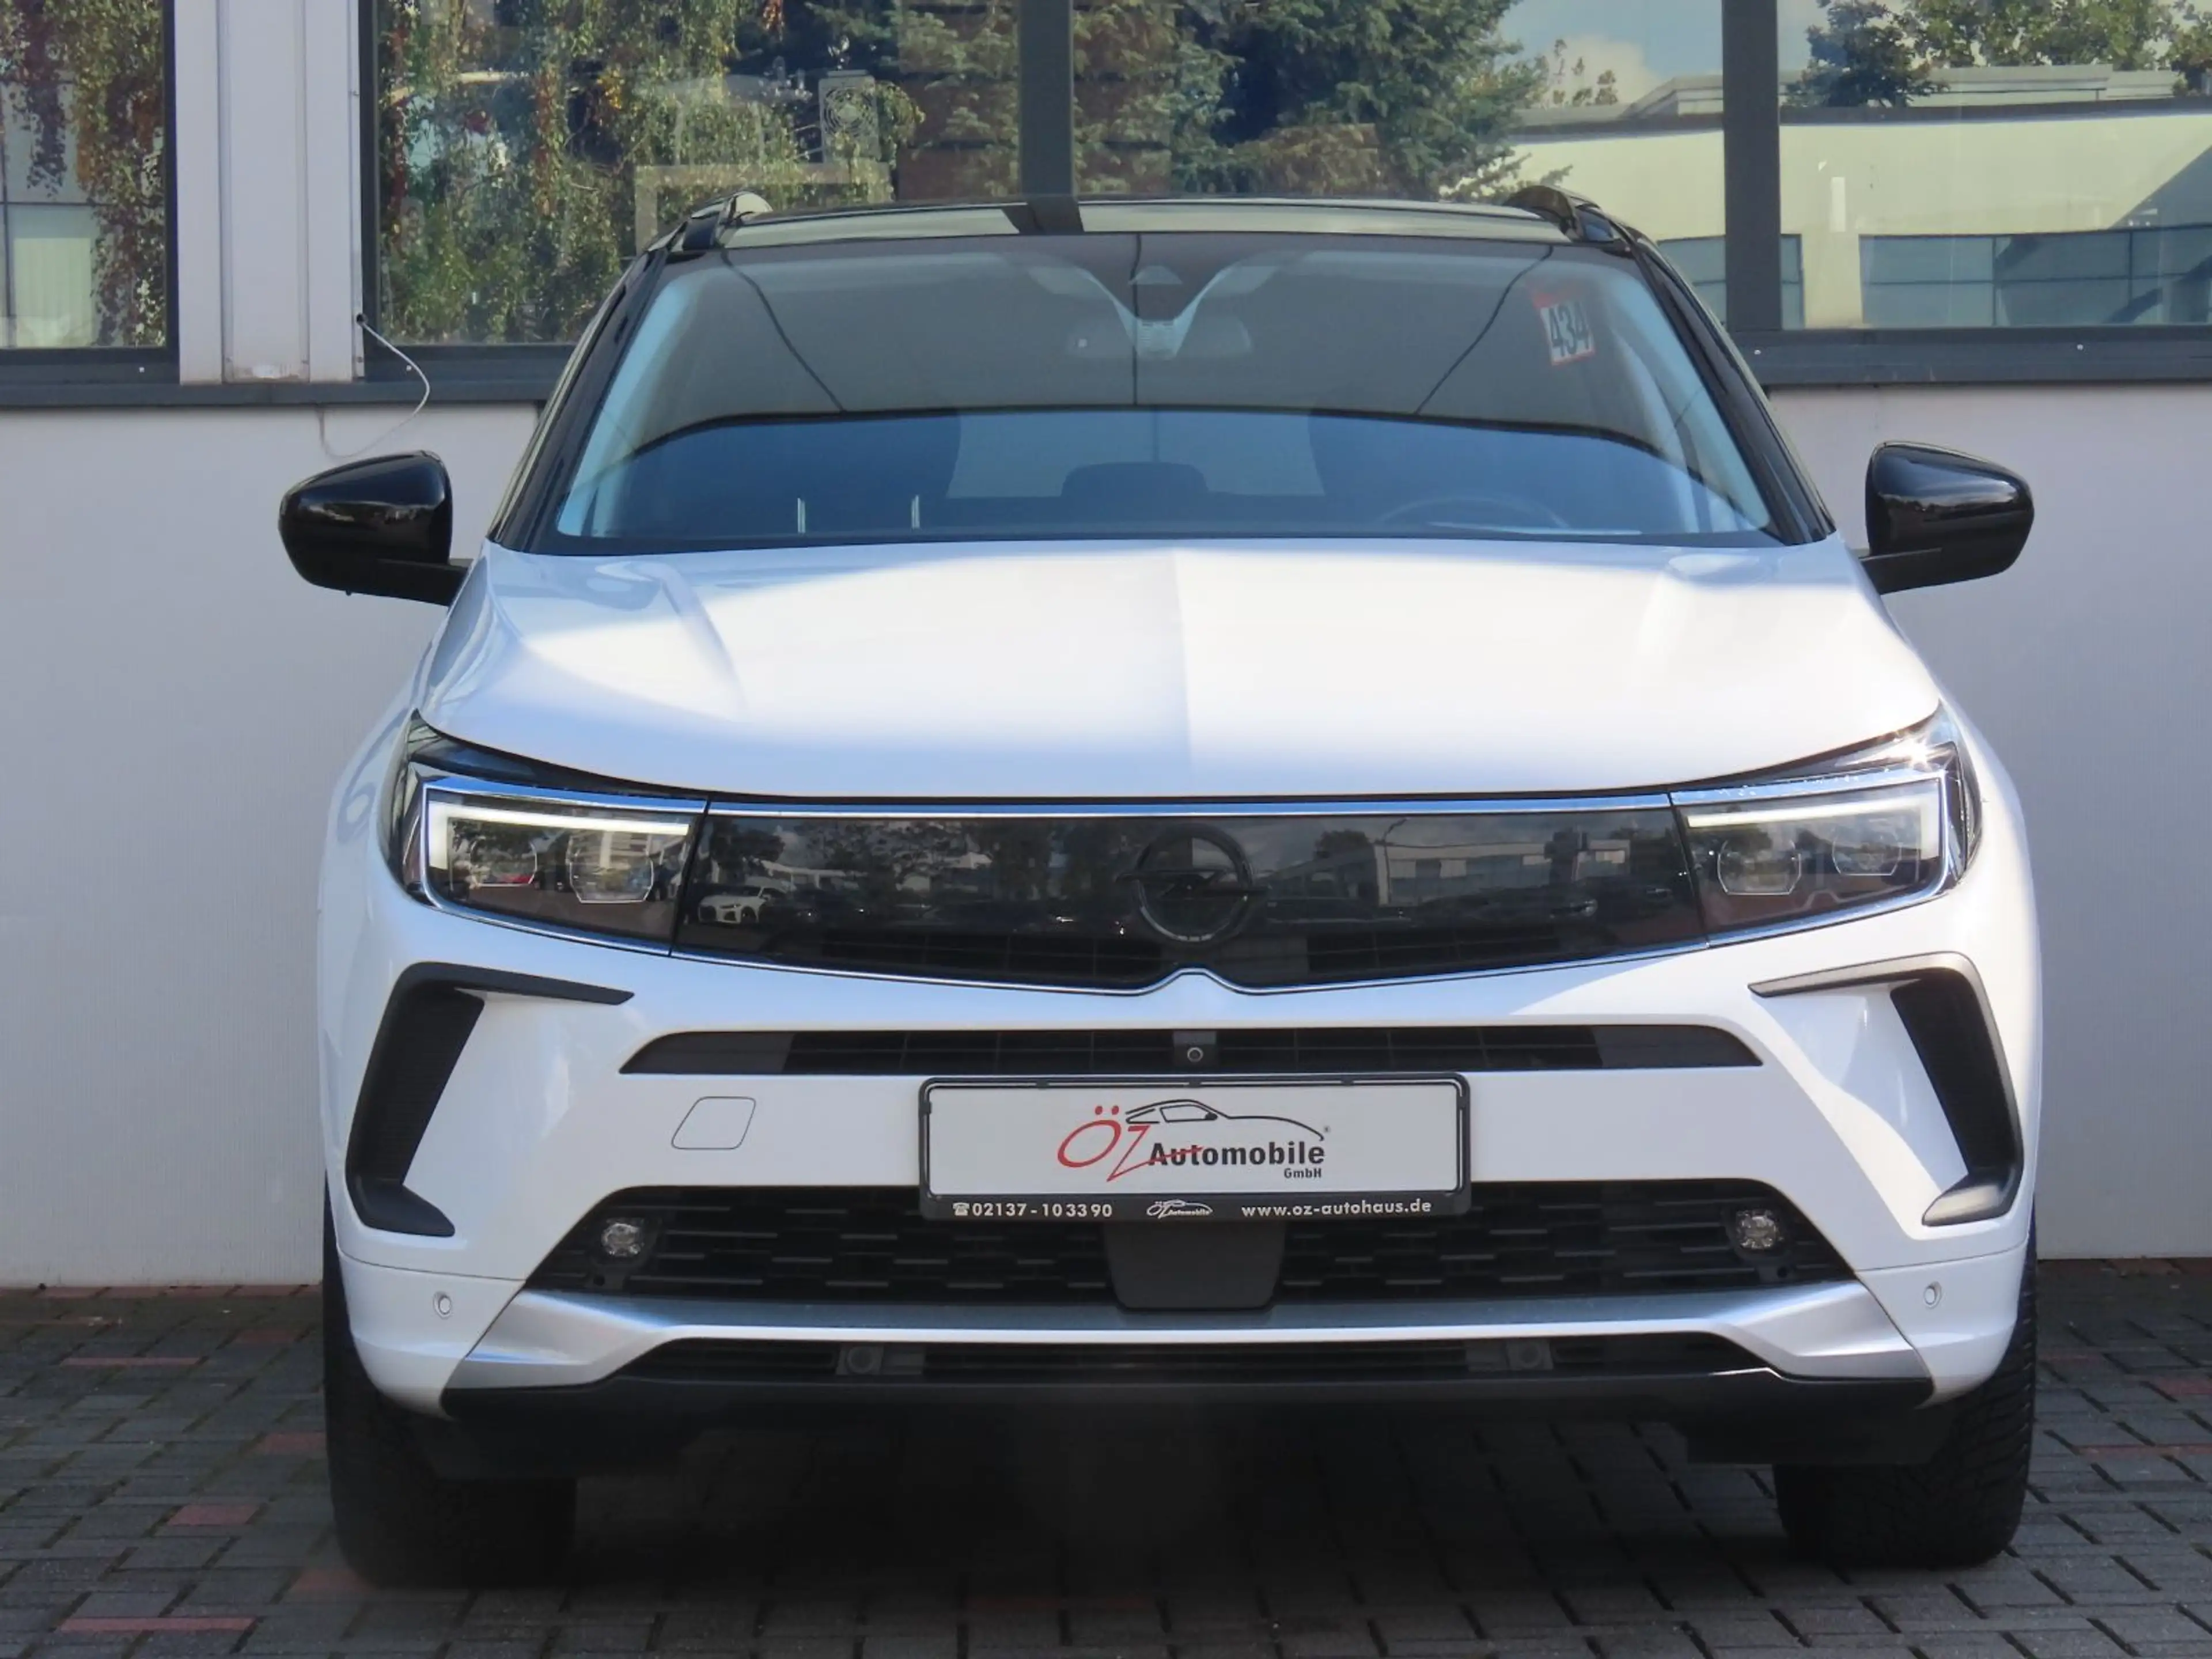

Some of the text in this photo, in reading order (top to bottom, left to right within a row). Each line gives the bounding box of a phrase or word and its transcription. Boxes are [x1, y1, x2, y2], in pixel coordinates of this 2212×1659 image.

[1149, 1141, 1325, 1165] Automobile
[1284, 1168, 1322, 1179] GmbH
[1241, 1198, 1432, 1217] www.oz-autohaus.de
